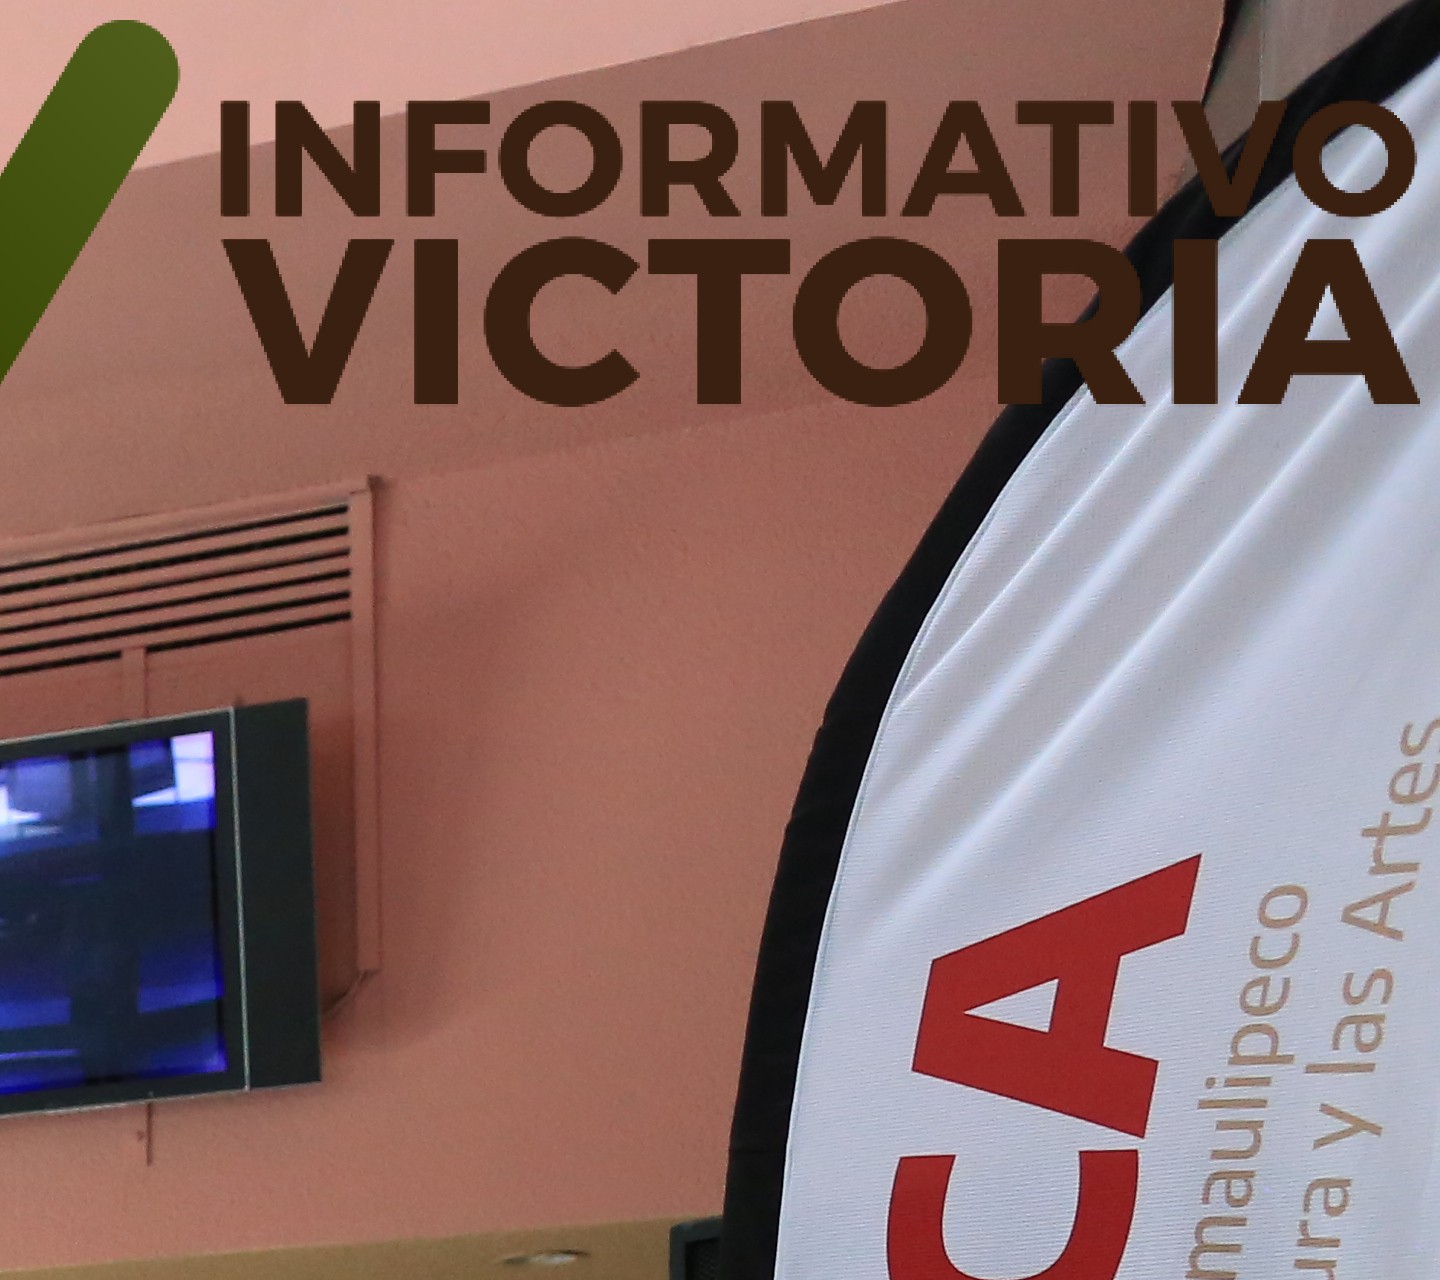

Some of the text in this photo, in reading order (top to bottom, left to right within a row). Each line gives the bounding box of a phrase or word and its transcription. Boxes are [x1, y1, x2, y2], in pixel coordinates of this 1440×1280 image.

[1340, 716, 1440, 942] Artes
[1304, 966, 1397, 1075] las
[1312, 1102, 1385, 1150] y
